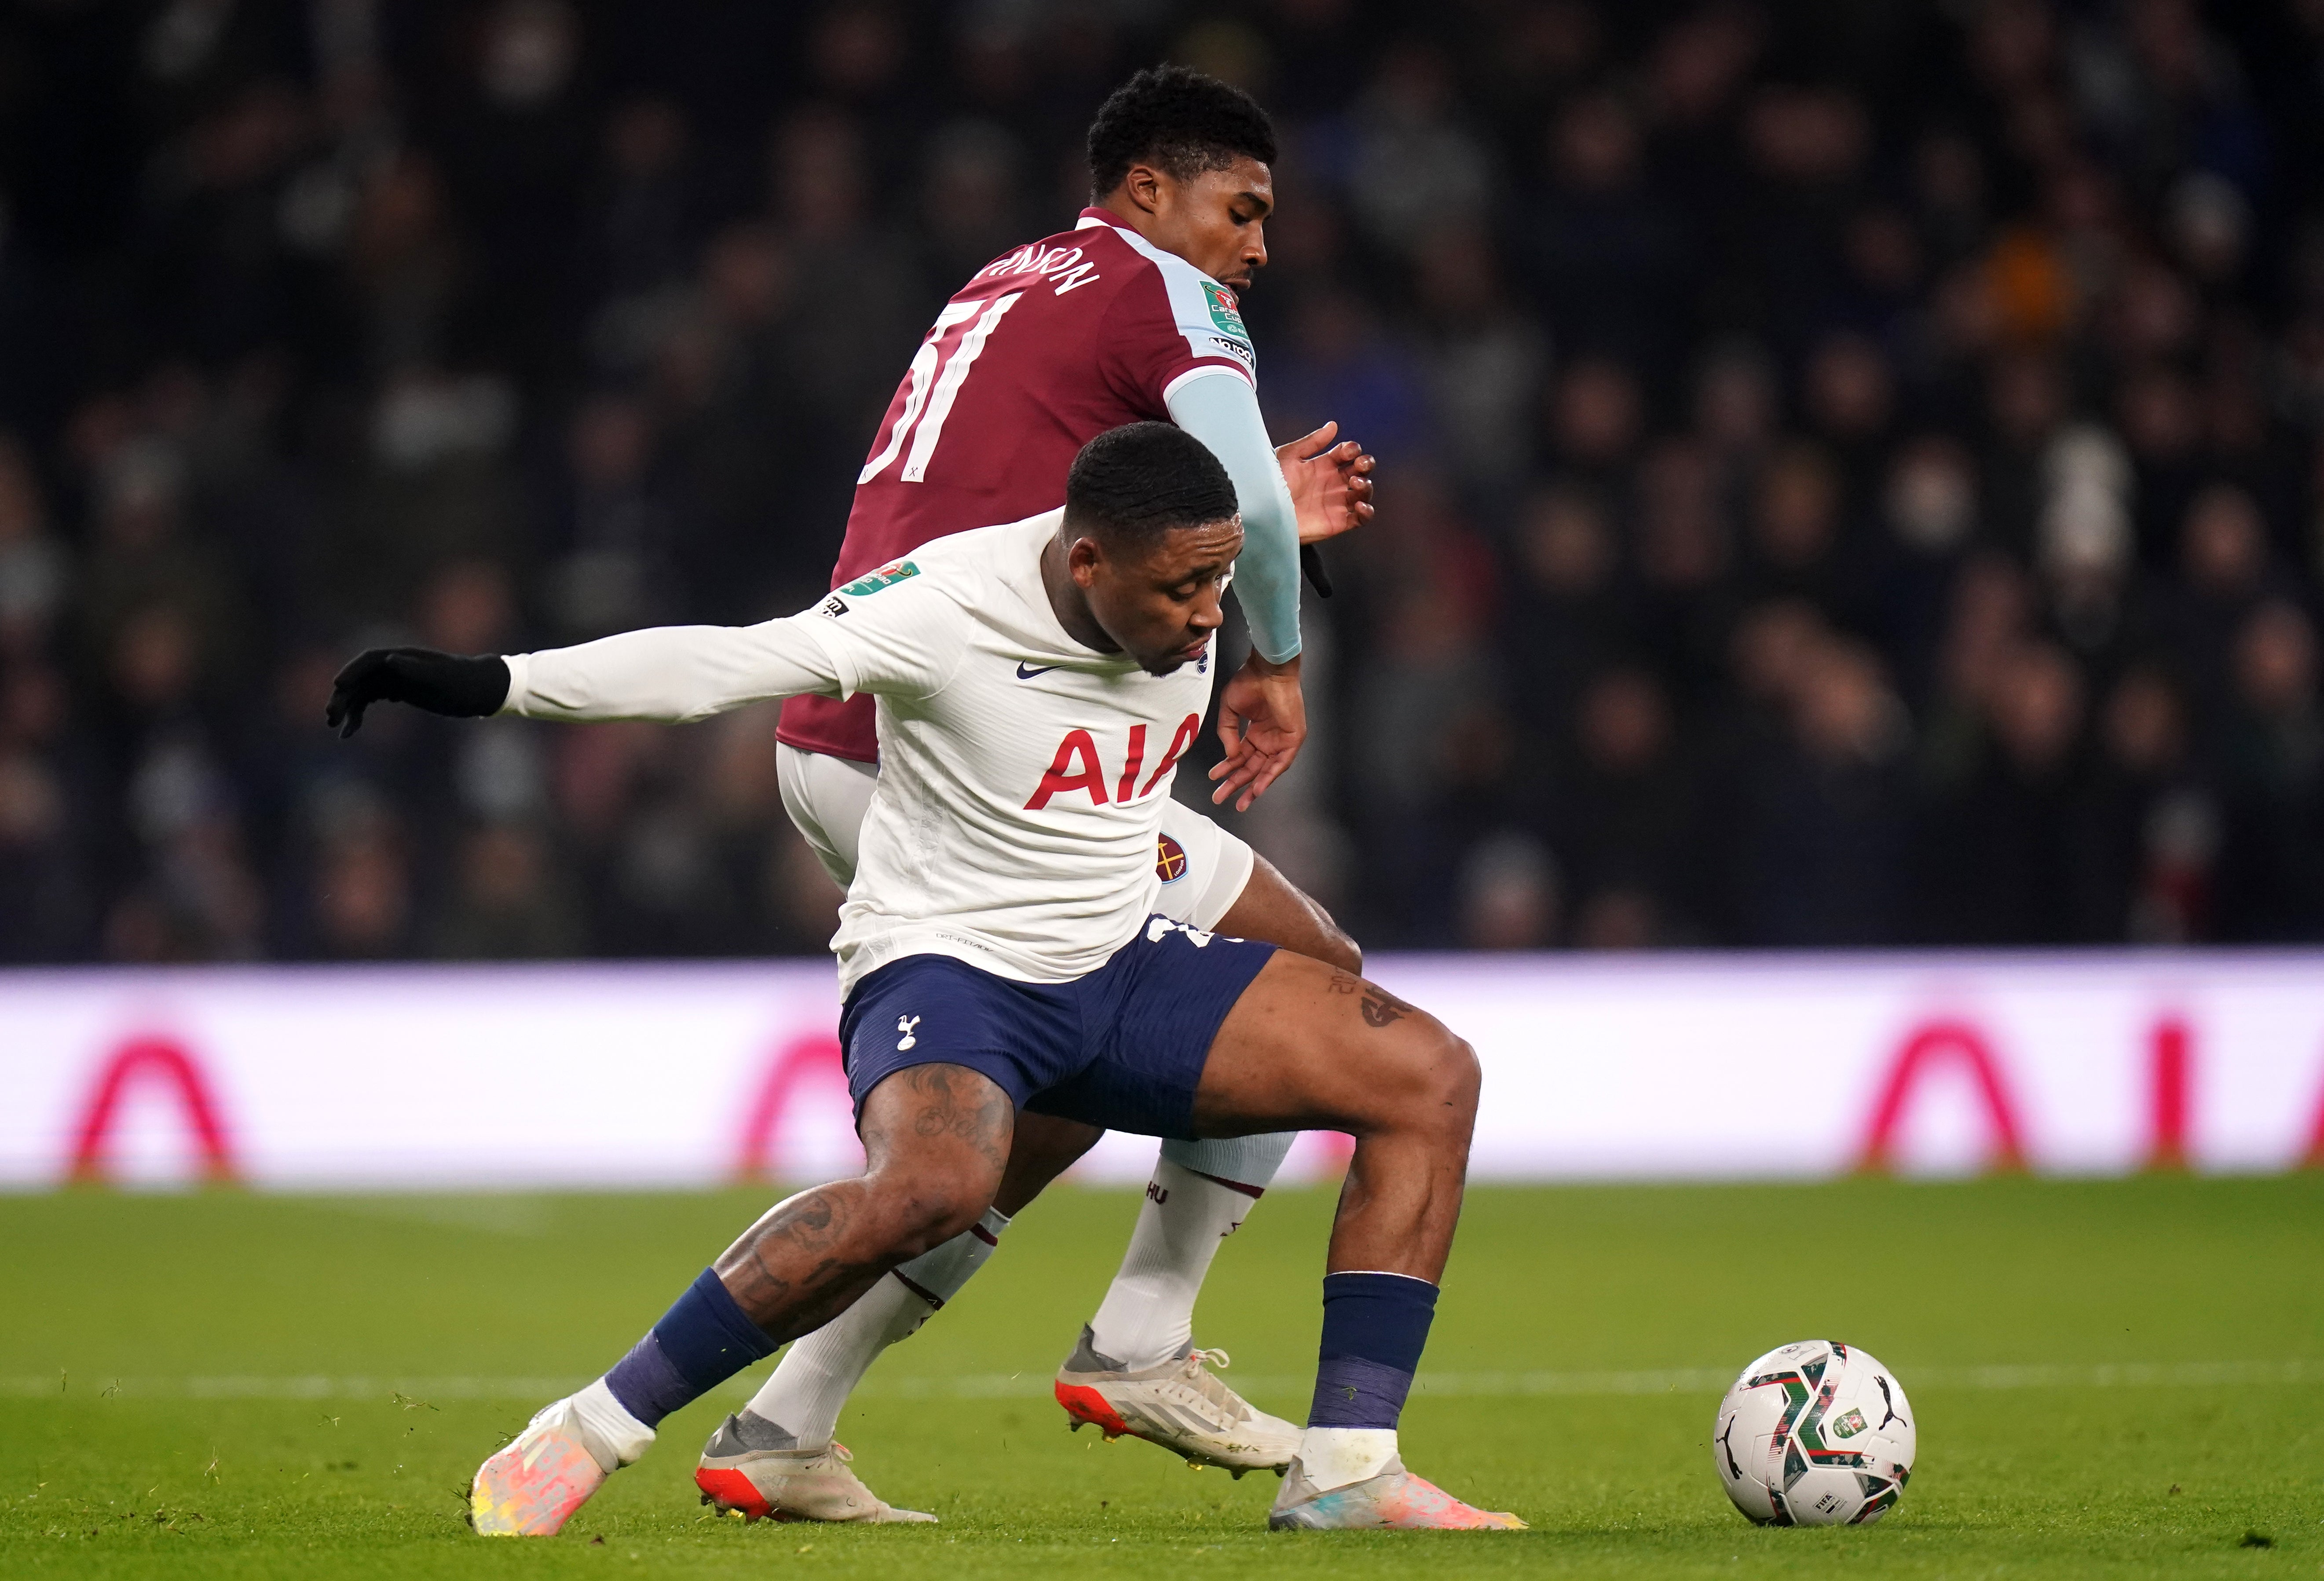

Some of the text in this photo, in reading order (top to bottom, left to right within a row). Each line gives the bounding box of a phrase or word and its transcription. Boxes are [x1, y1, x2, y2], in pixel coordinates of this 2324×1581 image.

[1023, 713, 1200, 810] AIA
[1174, 859, 1184, 877] LONDON
[1815, 1495, 1832, 1509] FIFA
